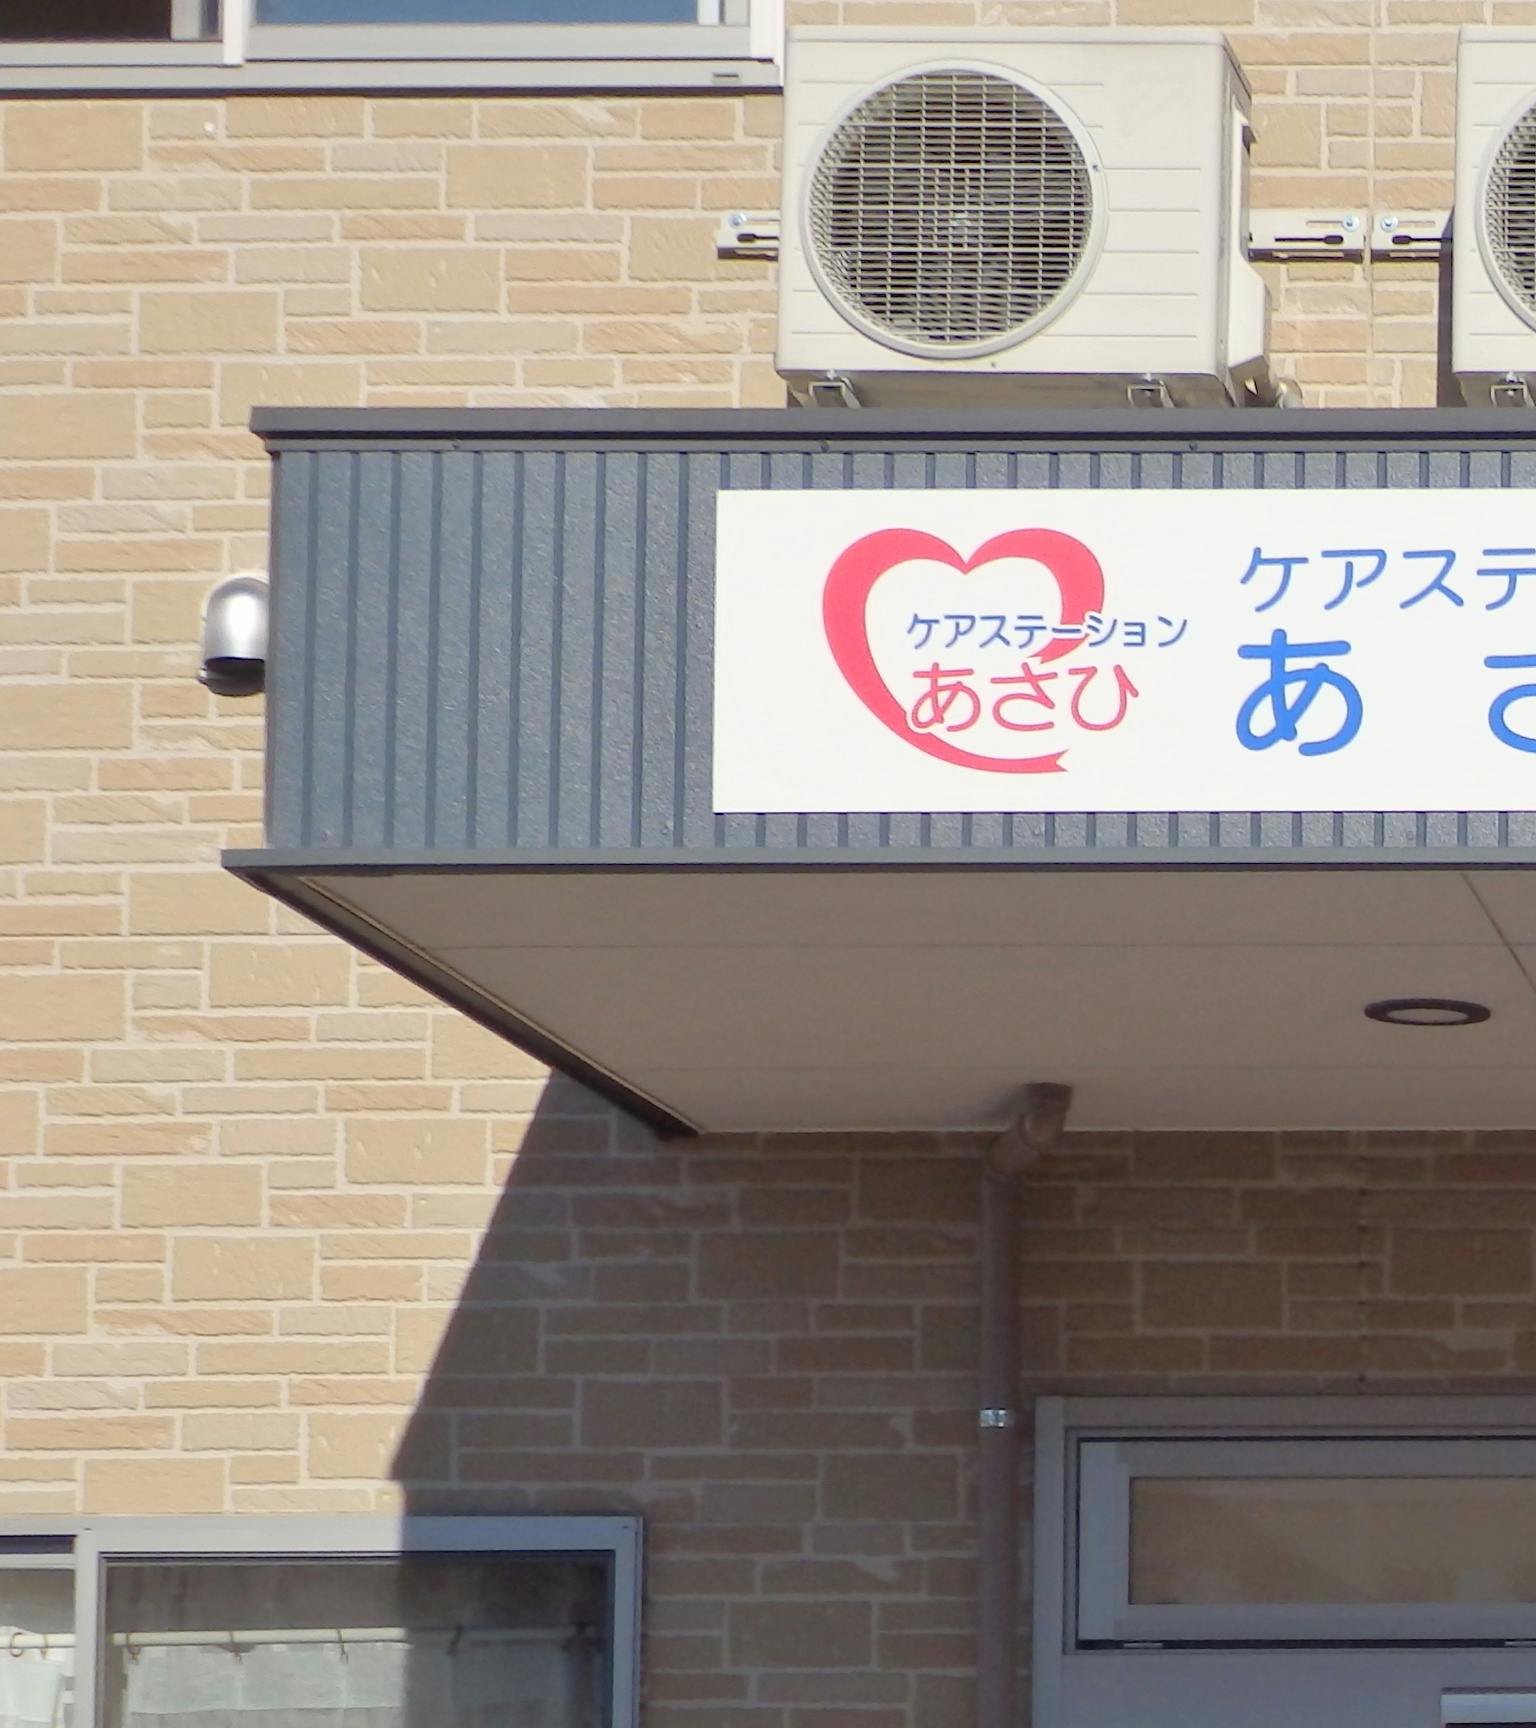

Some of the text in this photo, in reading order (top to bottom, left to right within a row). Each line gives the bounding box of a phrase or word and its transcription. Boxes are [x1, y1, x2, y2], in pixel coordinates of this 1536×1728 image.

[907, 613, 1188, 649] ケアステーション
[911, 661, 1139, 732] あさひ
